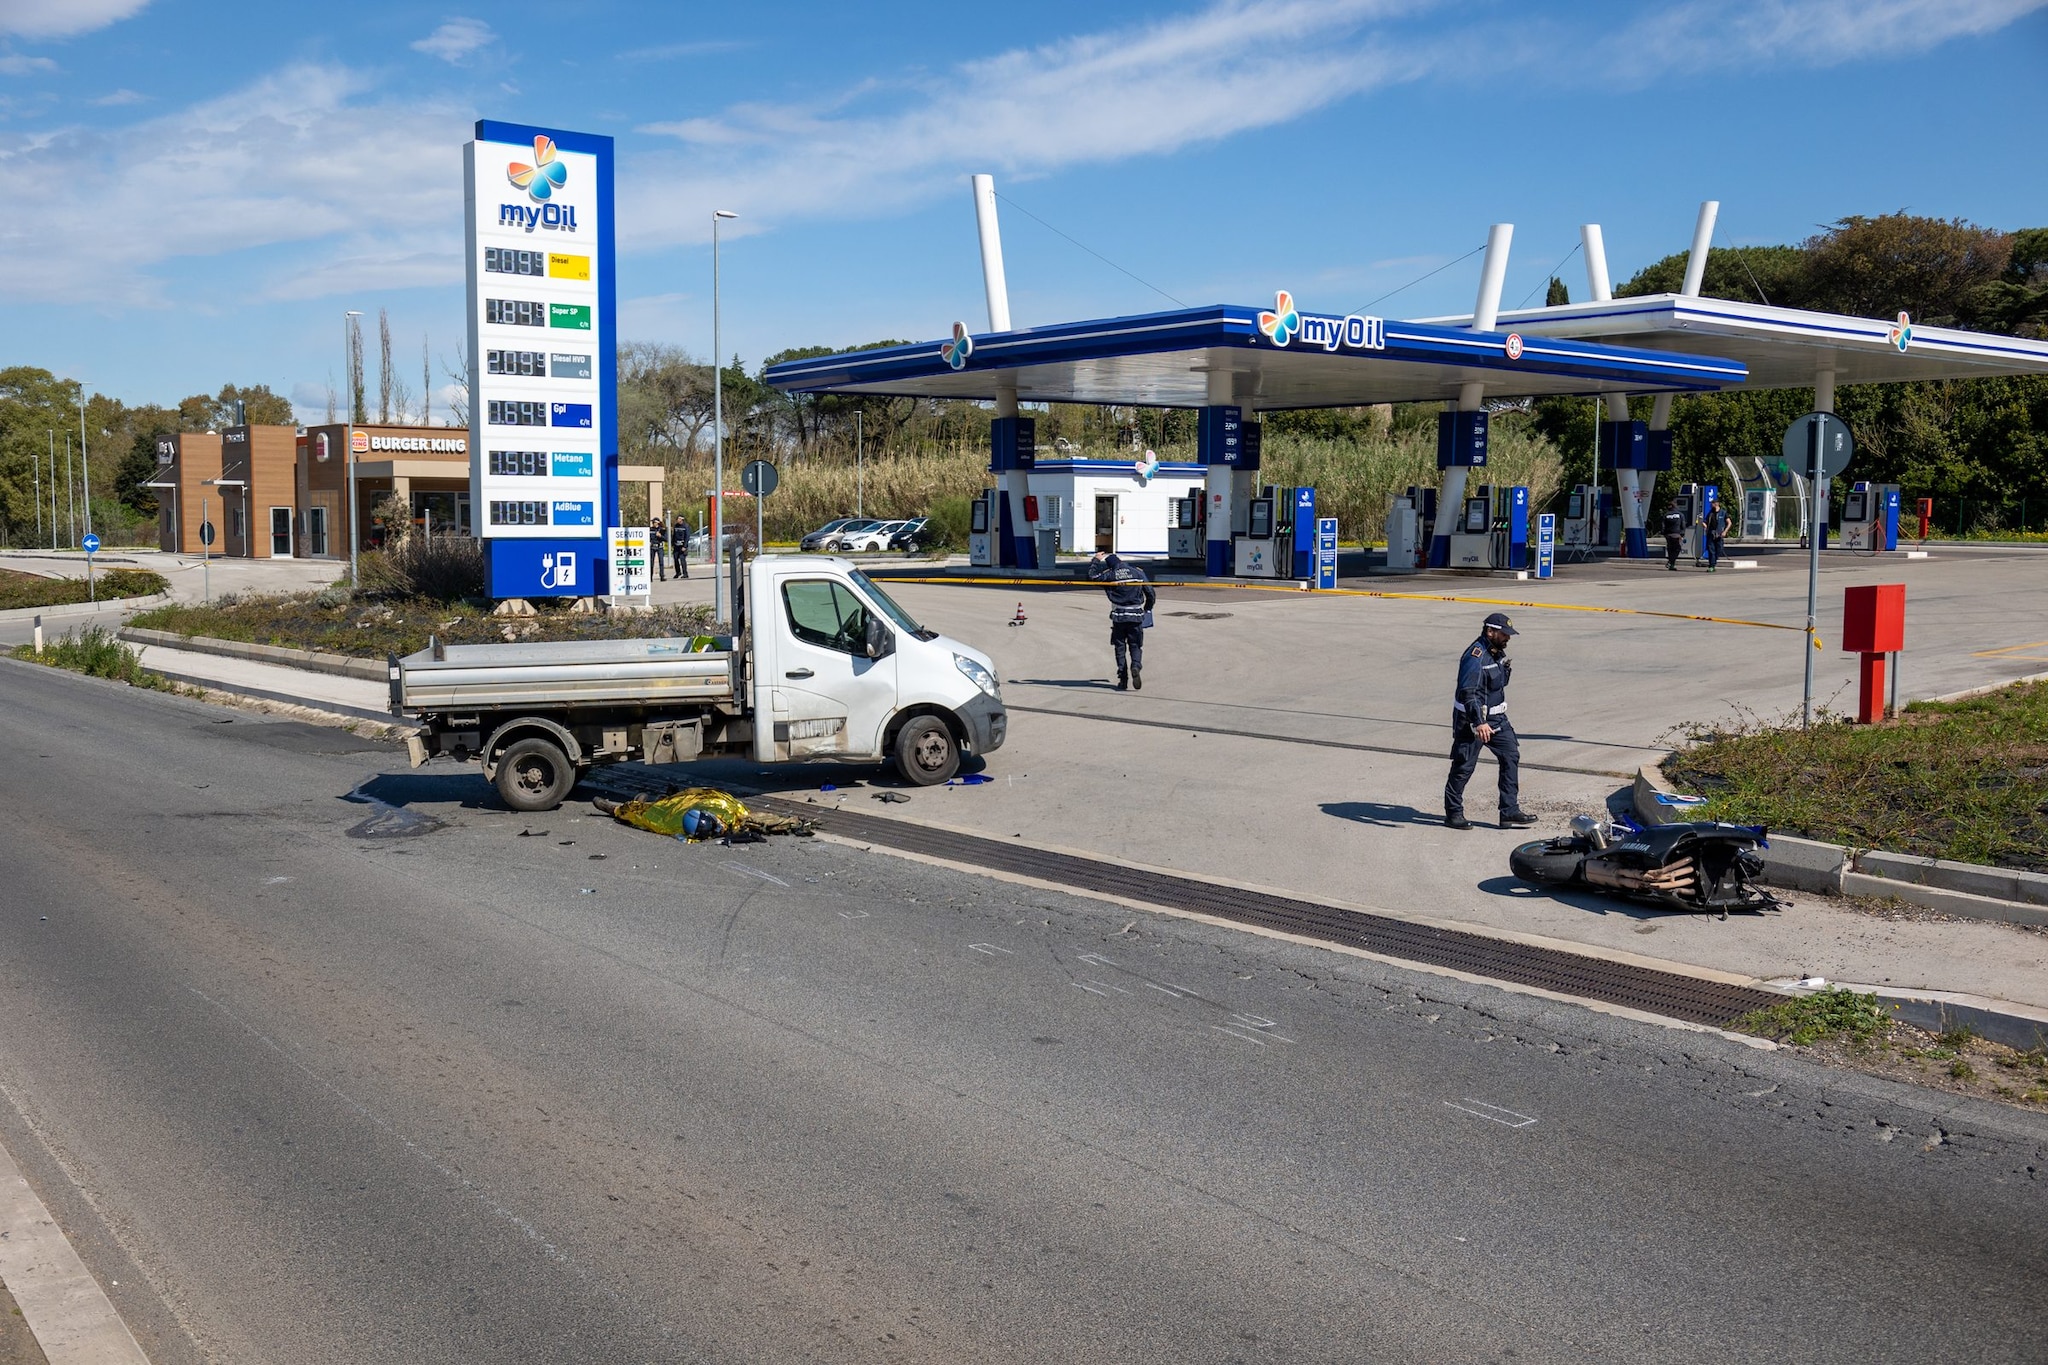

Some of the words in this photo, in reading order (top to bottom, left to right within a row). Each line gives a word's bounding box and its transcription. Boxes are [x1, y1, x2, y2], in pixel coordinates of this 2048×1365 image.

[500, 203, 577, 228] myOil
[551, 256, 569, 264] Diesel
[551, 306, 569, 316] Super
[1302, 317, 1384, 350] myOil
[552, 354, 572, 363] Diesel
[572, 355, 585, 363] HVO
[553, 404, 566, 415] Gpl
[371, 436, 428, 451] BURGER
[431, 438, 466, 452] KING
[554, 453, 584, 463] Metano
[555, 502, 582, 511] AdBlue
[1462, 555, 1479, 563] myOil
[1246, 563, 1263, 572] myOil
[626, 583, 648, 592] myOil
[1620, 842, 1651, 852] YAMAHA
